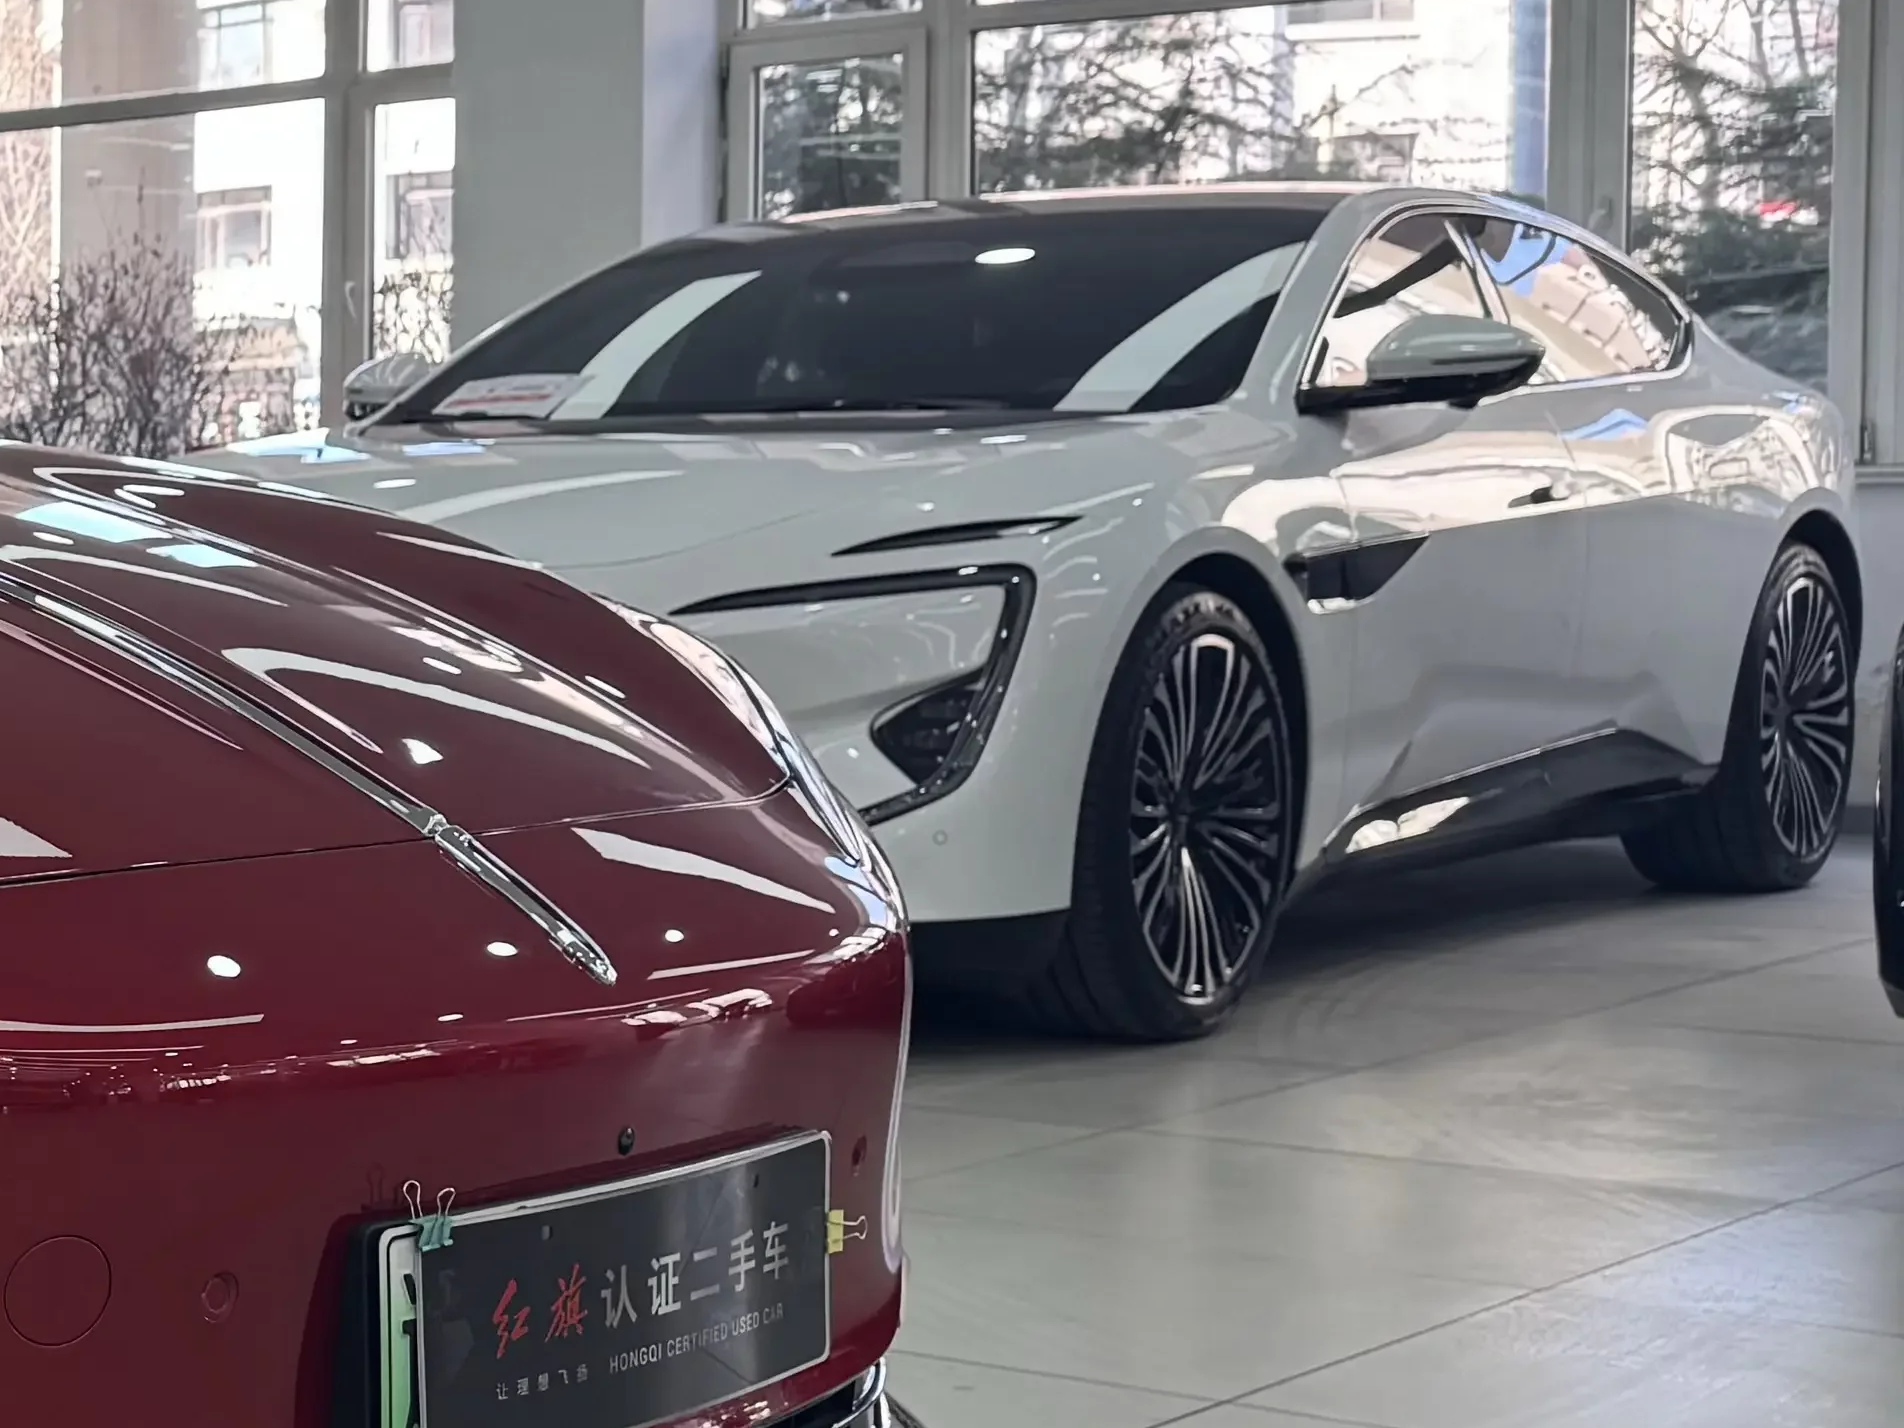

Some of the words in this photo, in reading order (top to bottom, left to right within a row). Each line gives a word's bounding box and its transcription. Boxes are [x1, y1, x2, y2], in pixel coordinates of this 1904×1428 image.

[609, 1342, 663, 1374] HONGQI
[666, 1322, 729, 1358] CERTIFIED
[731, 1311, 760, 1337] USED
[762, 1301, 784, 1325] CAR
